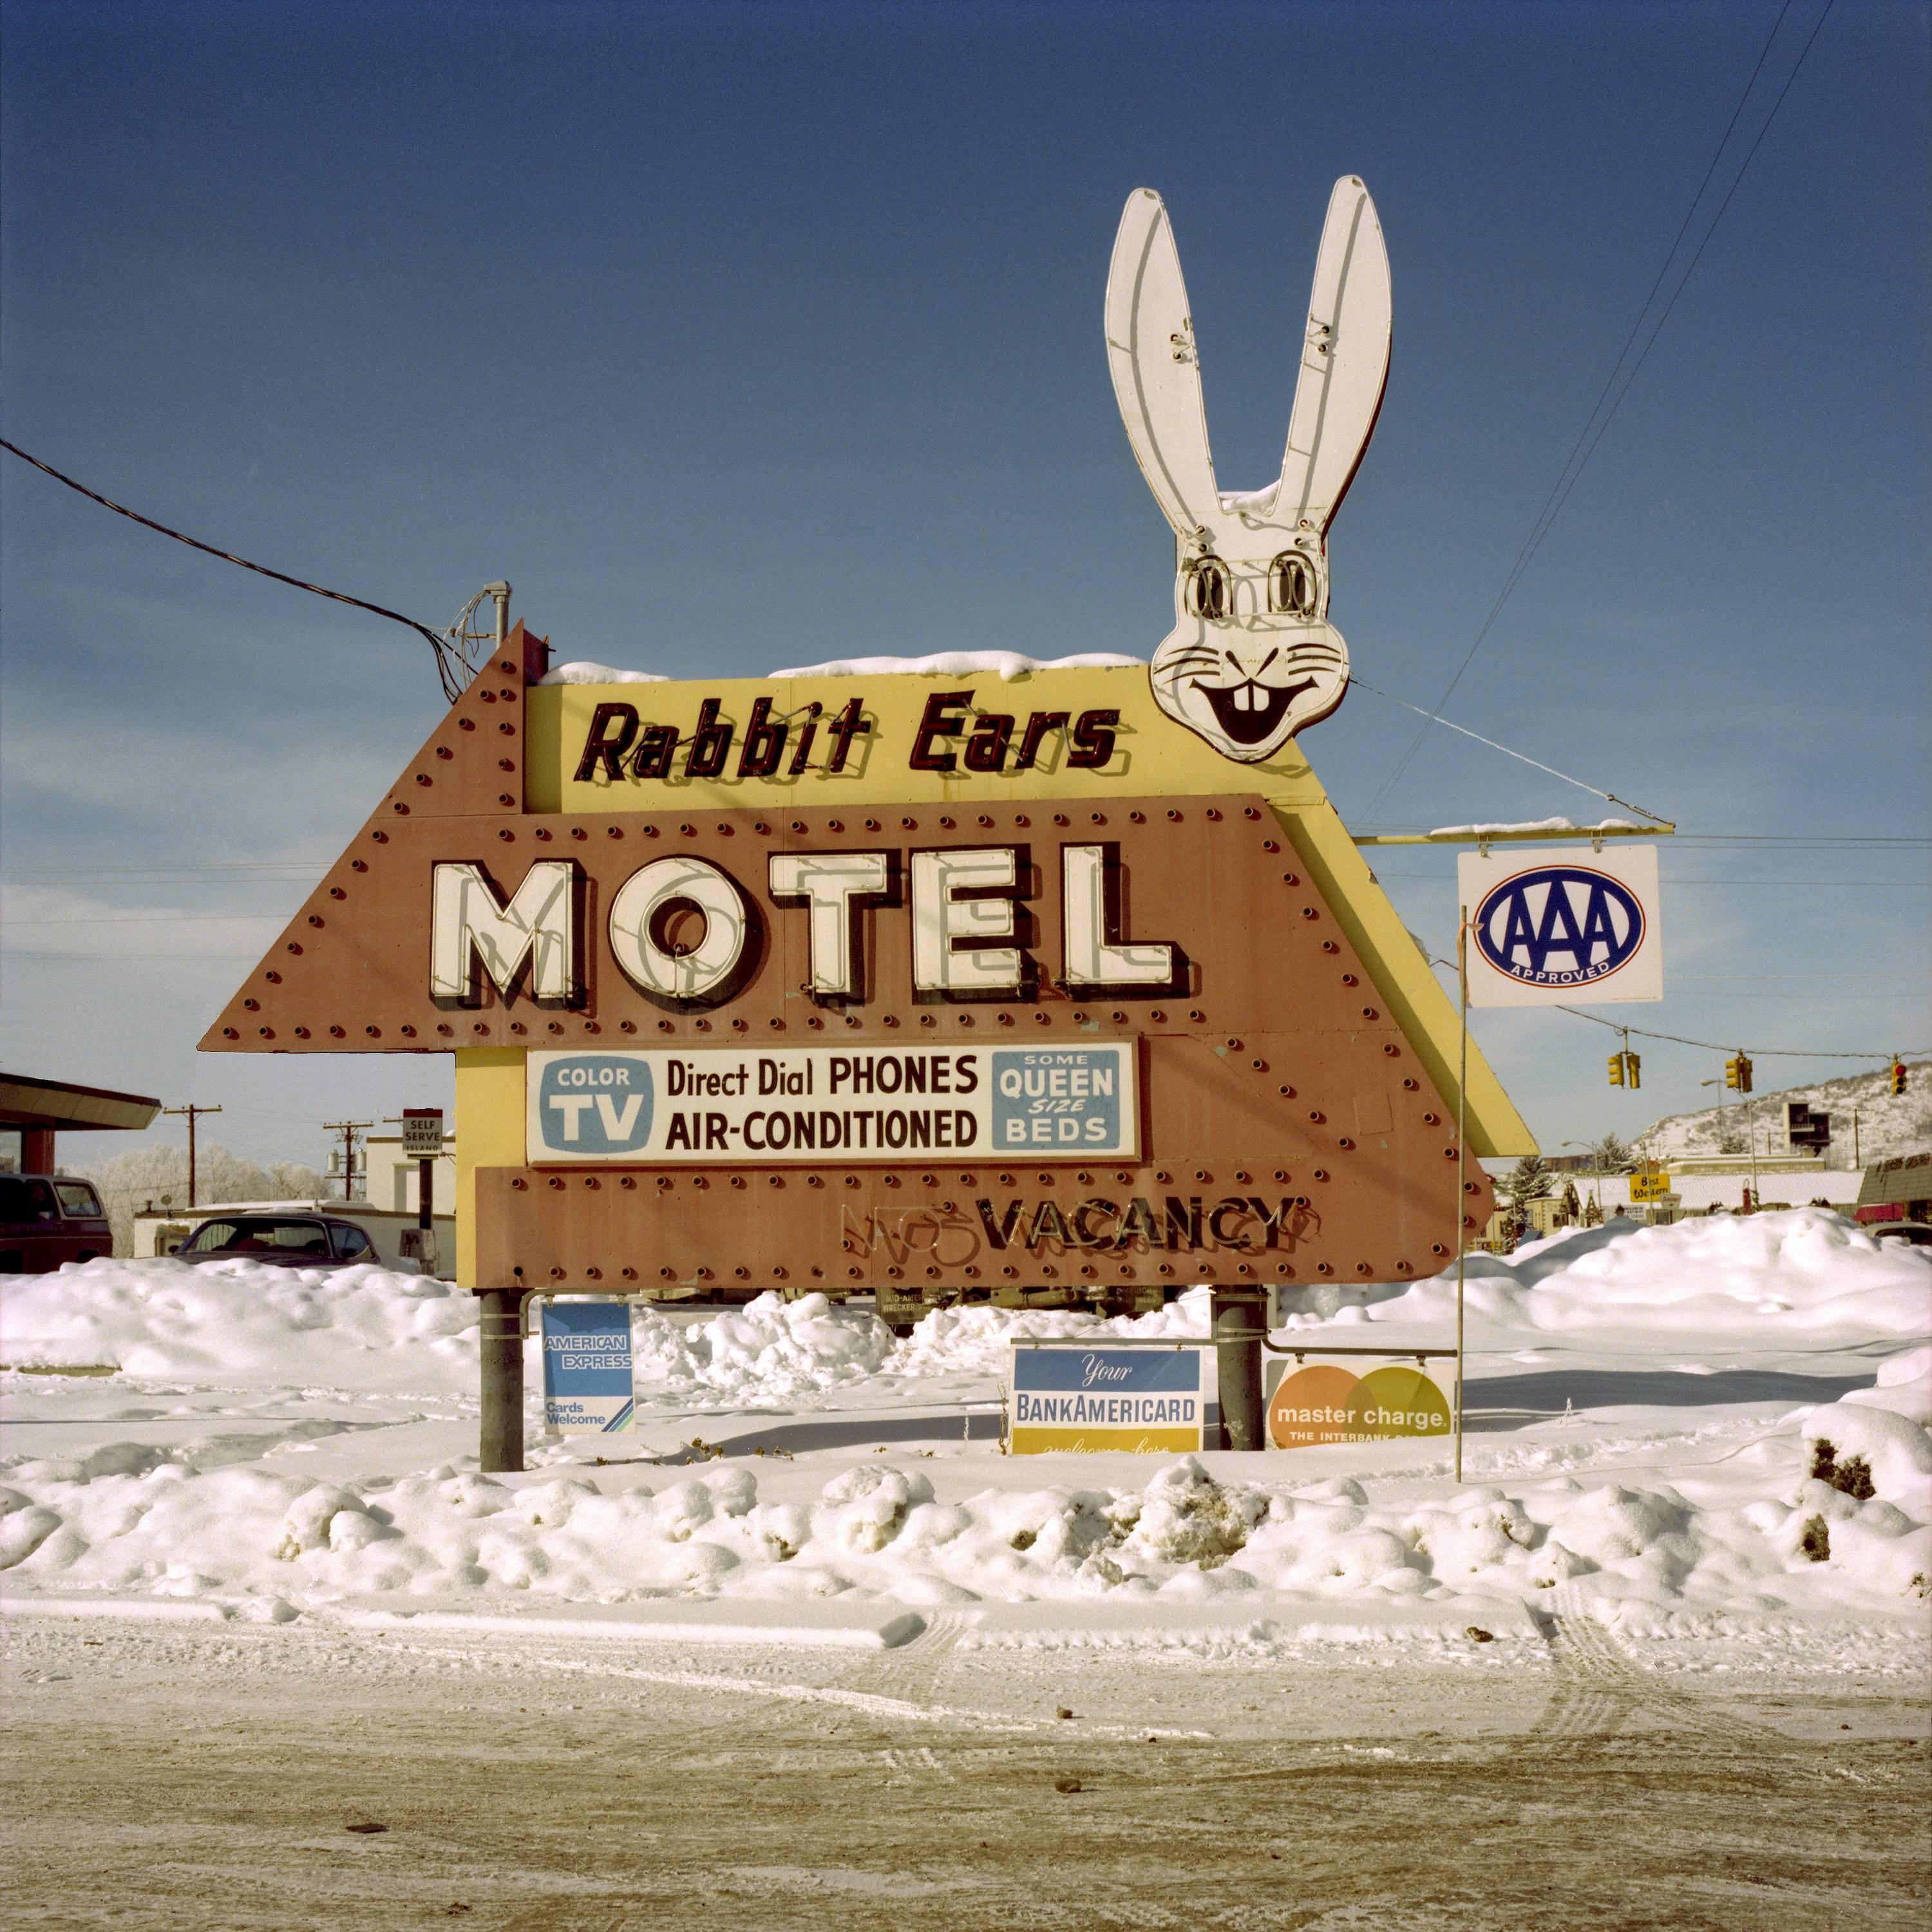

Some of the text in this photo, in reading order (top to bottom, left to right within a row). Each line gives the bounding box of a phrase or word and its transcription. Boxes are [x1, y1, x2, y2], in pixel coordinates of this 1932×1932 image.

[573, 689, 1121, 782] Rabbit Ears
[430, 843, 1182, 1006] MOTEL
[1499, 877, 1623, 972] AAA
[1511, 962, 1610, 983] APPROVED
[1024, 1055, 1088, 1066] SOME
[557, 1068, 631, 1086] COLOR
[667, 1054, 979, 1097] Direct Dial PHONES
[999, 1068, 1113, 1099] QUEEN
[1027, 1098, 1086, 1115] SIZE
[410, 1121, 435, 1130] SELF
[549, 1094, 644, 1141] TV
[405, 1132, 440, 1141] SERVE
[665, 1110, 978, 1150] AIR-CONDITIONED
[1006, 1117, 1108, 1142] BEDS
[1634, 1188, 1668, 1198] Wetern
[841, 1197, 1296, 1253] NO VACANCY
[882, 1303, 915, 1312] WRECKER
[544, 1334, 627, 1351] AMERICAN
[562, 1354, 632, 1370] EXPRESS
[1081, 1353, 1133, 1387] Your
[546, 1401, 584, 1414] Cards
[547, 1413, 606, 1425] Welcome
[1277, 1405, 1443, 1430] master charge
[1289, 1431, 1314, 1441] THE
[1320, 1432, 1391, 1443] INTERBANK
